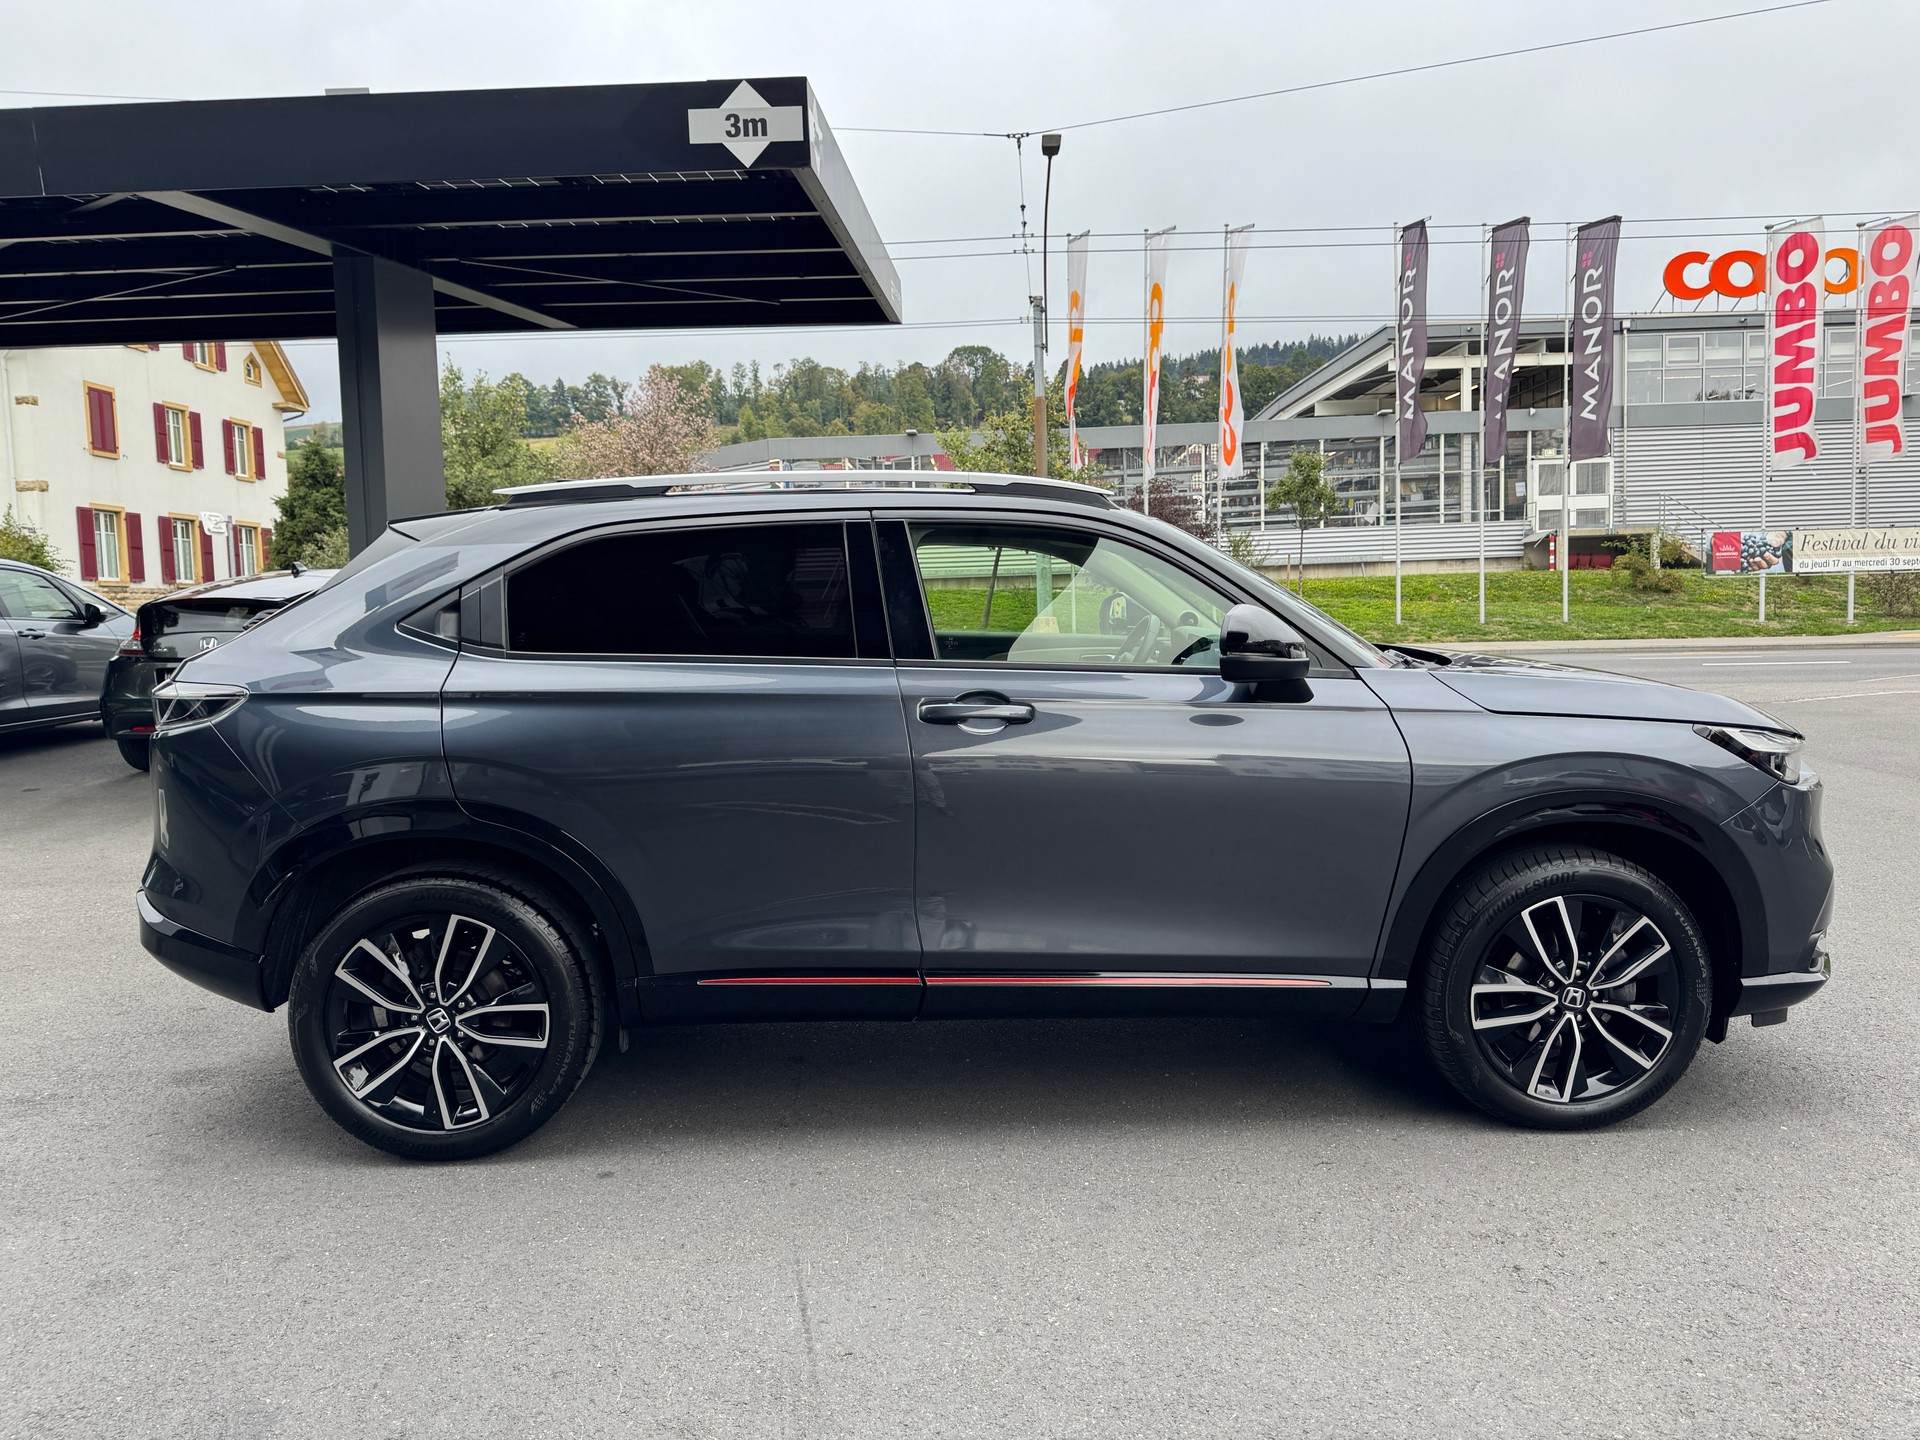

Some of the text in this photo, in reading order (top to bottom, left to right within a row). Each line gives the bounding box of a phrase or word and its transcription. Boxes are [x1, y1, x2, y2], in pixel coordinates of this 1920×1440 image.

[725, 113, 768, 138] 3m
[1400, 266, 1418, 421] MANOR
[1579, 264, 1604, 421] MANOR
[1773, 231, 1820, 461] JUMBO
[1863, 224, 1914, 454] JUMBO
[1799, 560, 1809, 569] du
[1810, 559, 1830, 570] jeudi
[1832, 559, 1840, 568] 17
[1854, 557, 1888, 567] mercredi
[1889, 557, 1901, 566] 30
[1800, 532, 1869, 552] Festival
[1874, 531, 1898, 550] du
[1480, 871, 1580, 927] BRIDGESTONE
[1673, 907, 1708, 978] TURANZA
[548, 1018, 577, 1095] TURANZA
